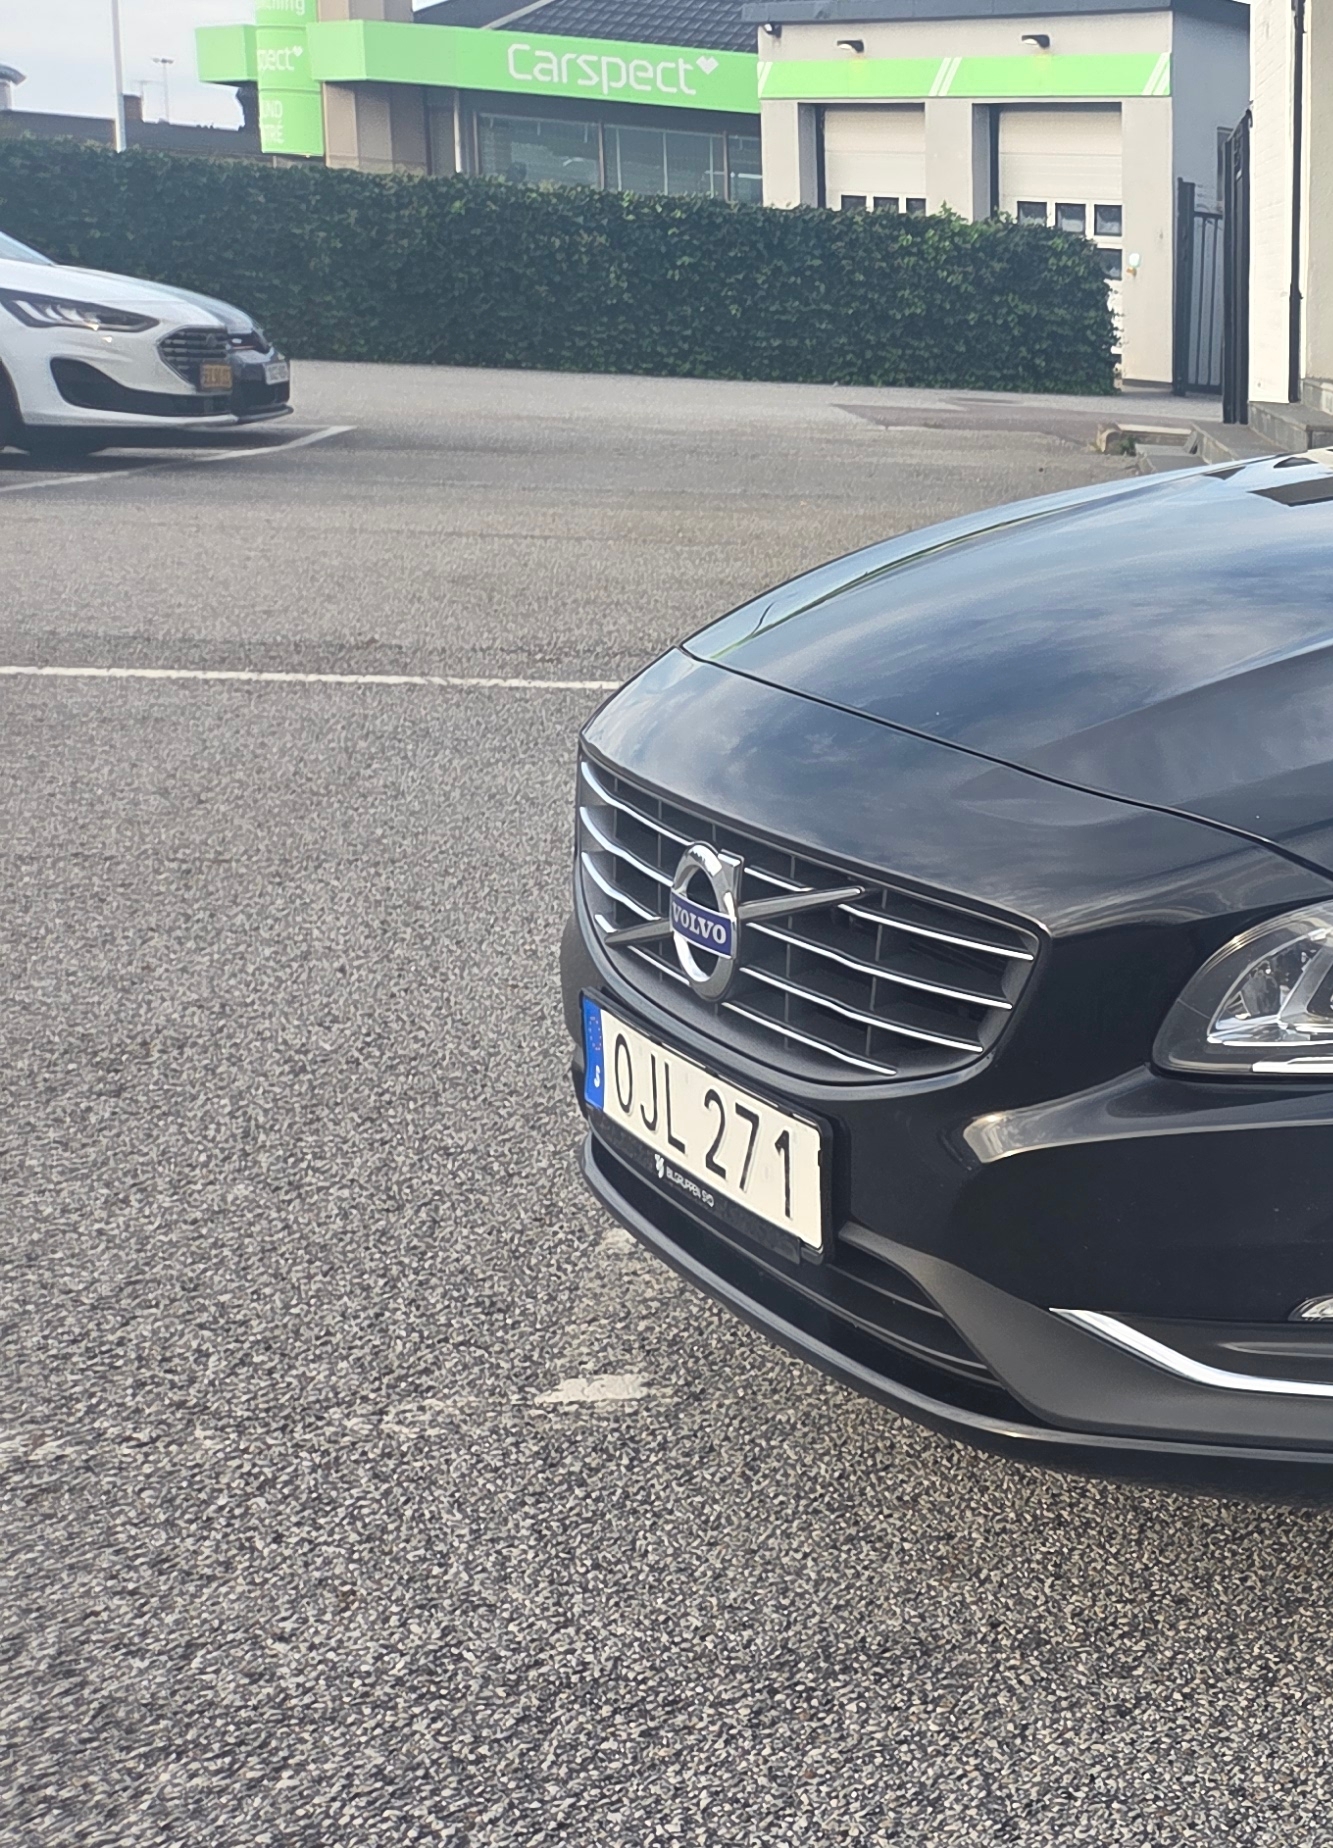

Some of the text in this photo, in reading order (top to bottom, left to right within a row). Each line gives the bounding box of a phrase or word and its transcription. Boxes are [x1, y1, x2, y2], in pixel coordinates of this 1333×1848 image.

[507, 43, 697, 96] Carspect
[672, 901, 727, 944] VOLVO
[593, 1065, 600, 1088] S
[614, 1033, 791, 1219] OJL 271
